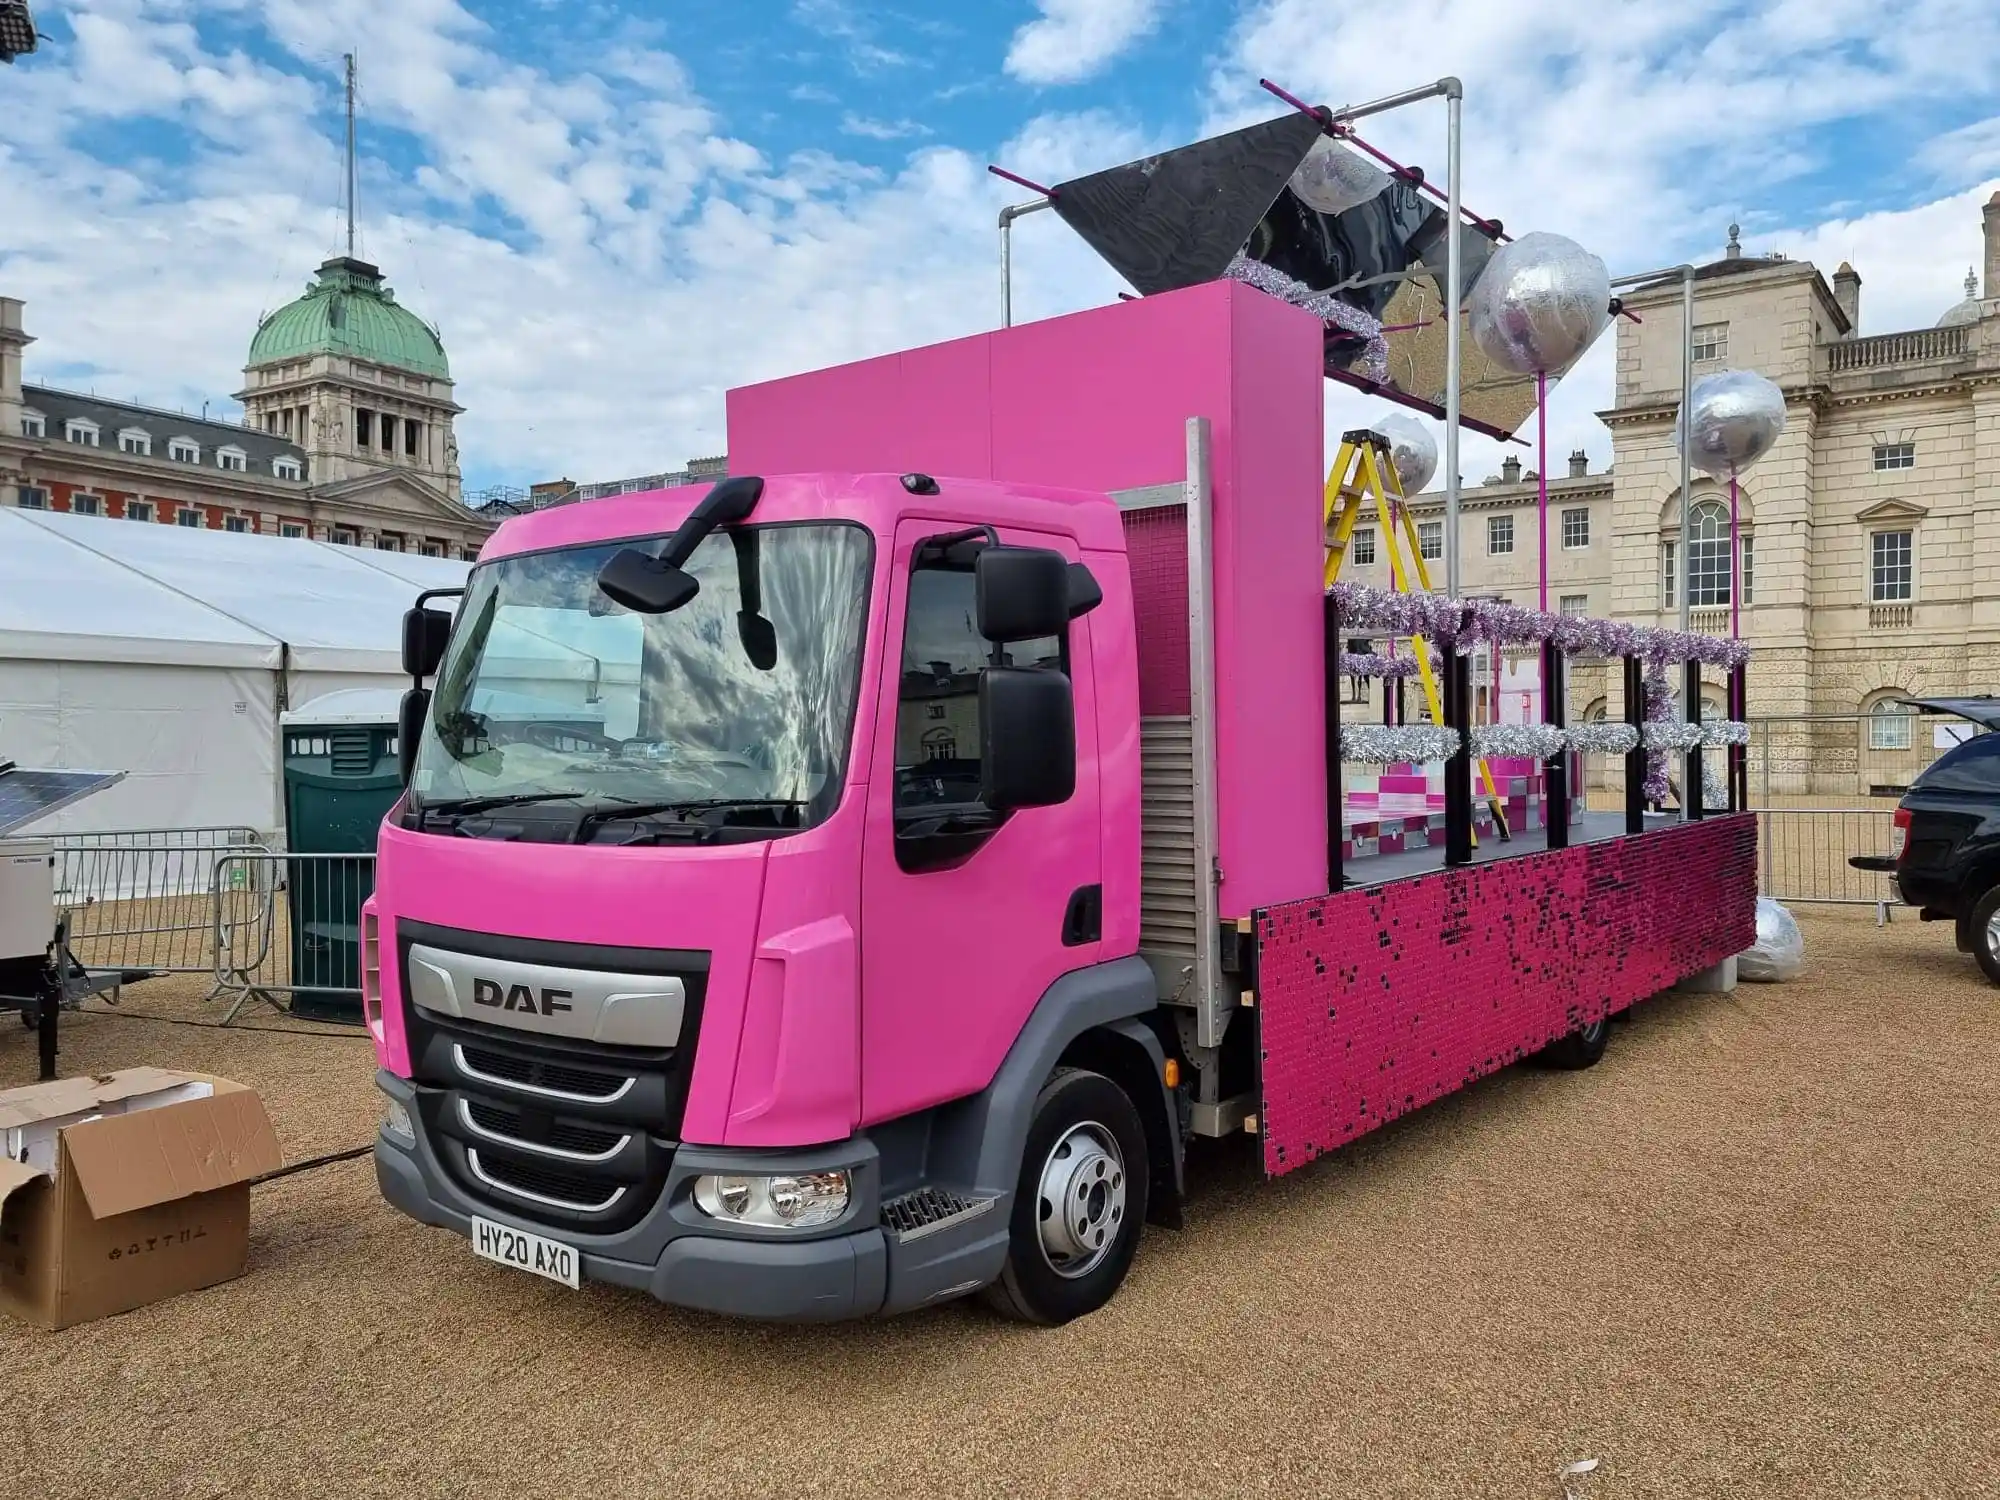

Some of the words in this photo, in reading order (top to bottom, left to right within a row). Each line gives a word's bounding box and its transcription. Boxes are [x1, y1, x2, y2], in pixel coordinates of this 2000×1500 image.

[474, 977, 572, 1016] DAF
[480, 1223, 528, 1265] HY20
[535, 1241, 571, 1280] AXO
